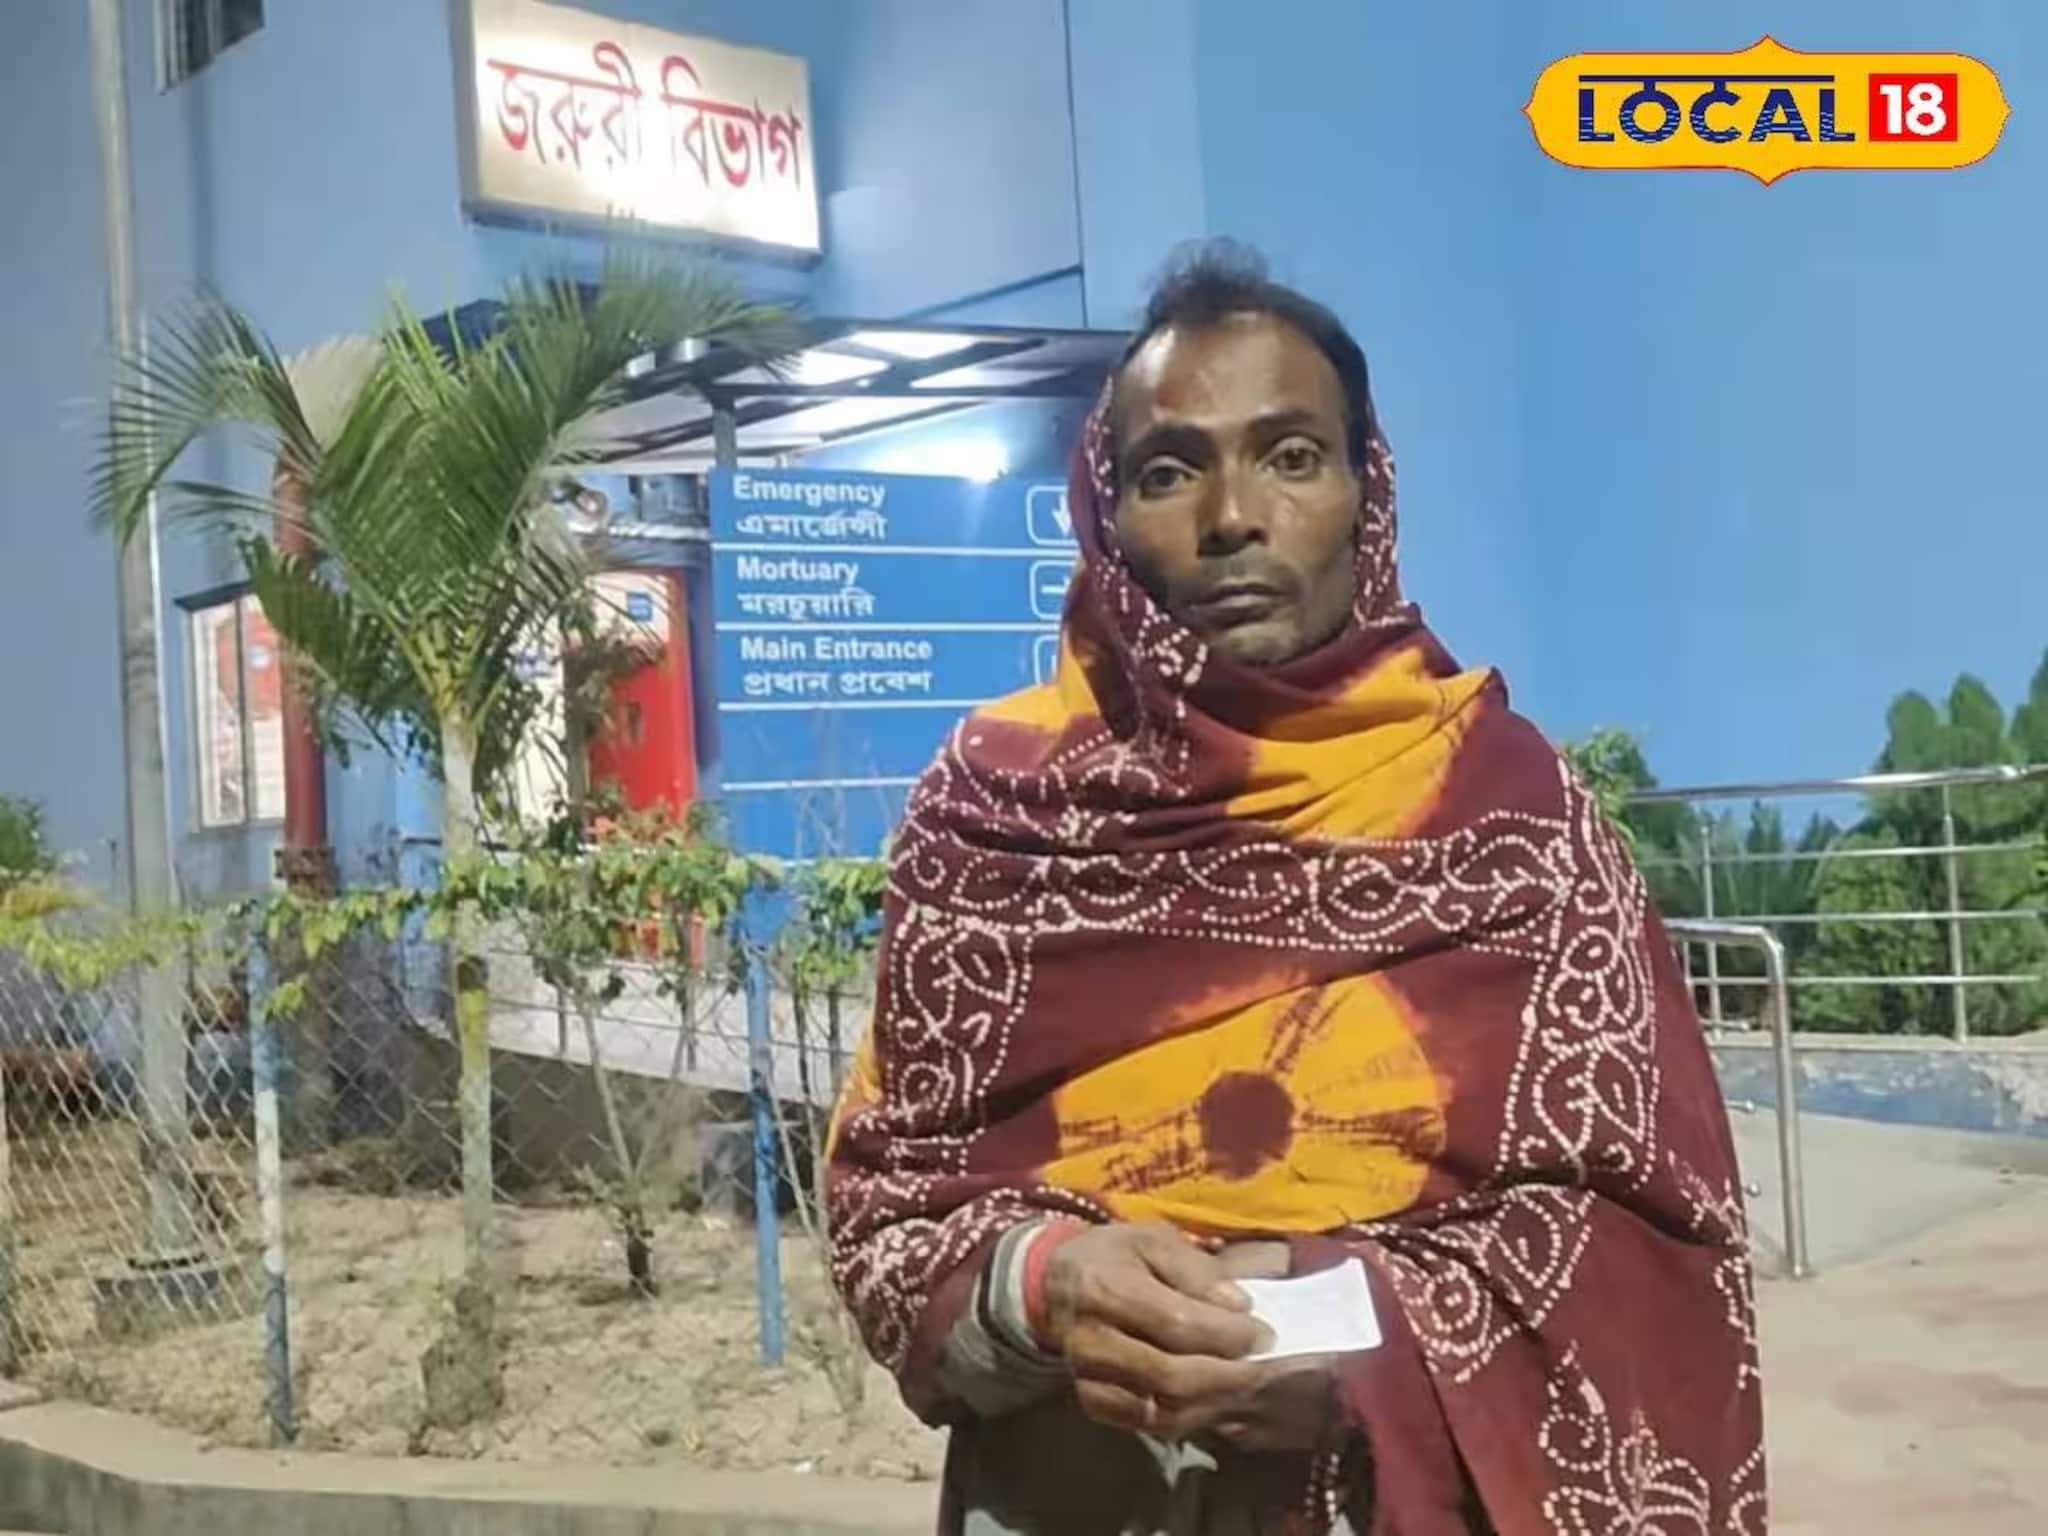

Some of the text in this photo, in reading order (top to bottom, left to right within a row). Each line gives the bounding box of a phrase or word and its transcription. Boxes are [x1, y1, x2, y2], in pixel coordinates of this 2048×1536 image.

[487, 41, 804, 190] জরুরী বিভাগ
[733, 474, 886, 508] Emergency
[736, 555, 859, 586] Mortuary
[740, 635, 933, 661] Main Entrance
[743, 670, 934, 697] প্রধান প্রবেশ
